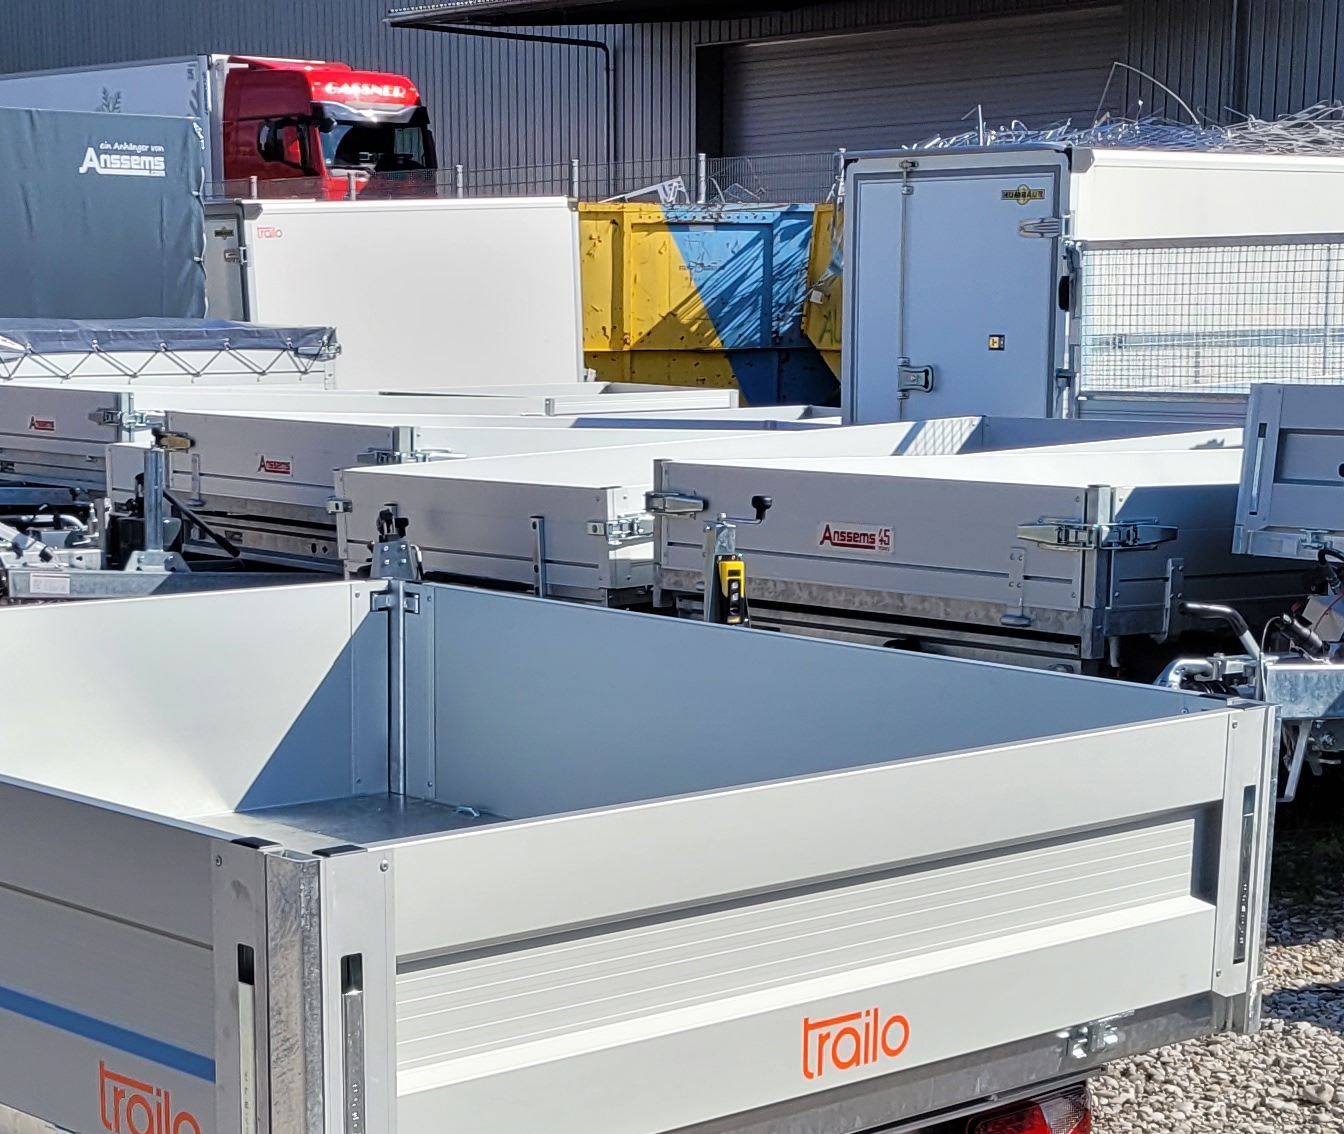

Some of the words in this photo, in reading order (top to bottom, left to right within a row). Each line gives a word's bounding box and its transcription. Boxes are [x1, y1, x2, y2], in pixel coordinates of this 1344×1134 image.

[324, 82, 406, 98] GASSNER
[78, 146, 166, 177] Anssems
[819, 524, 876, 550] Anssems
[802, 1007, 911, 1080] trailo
